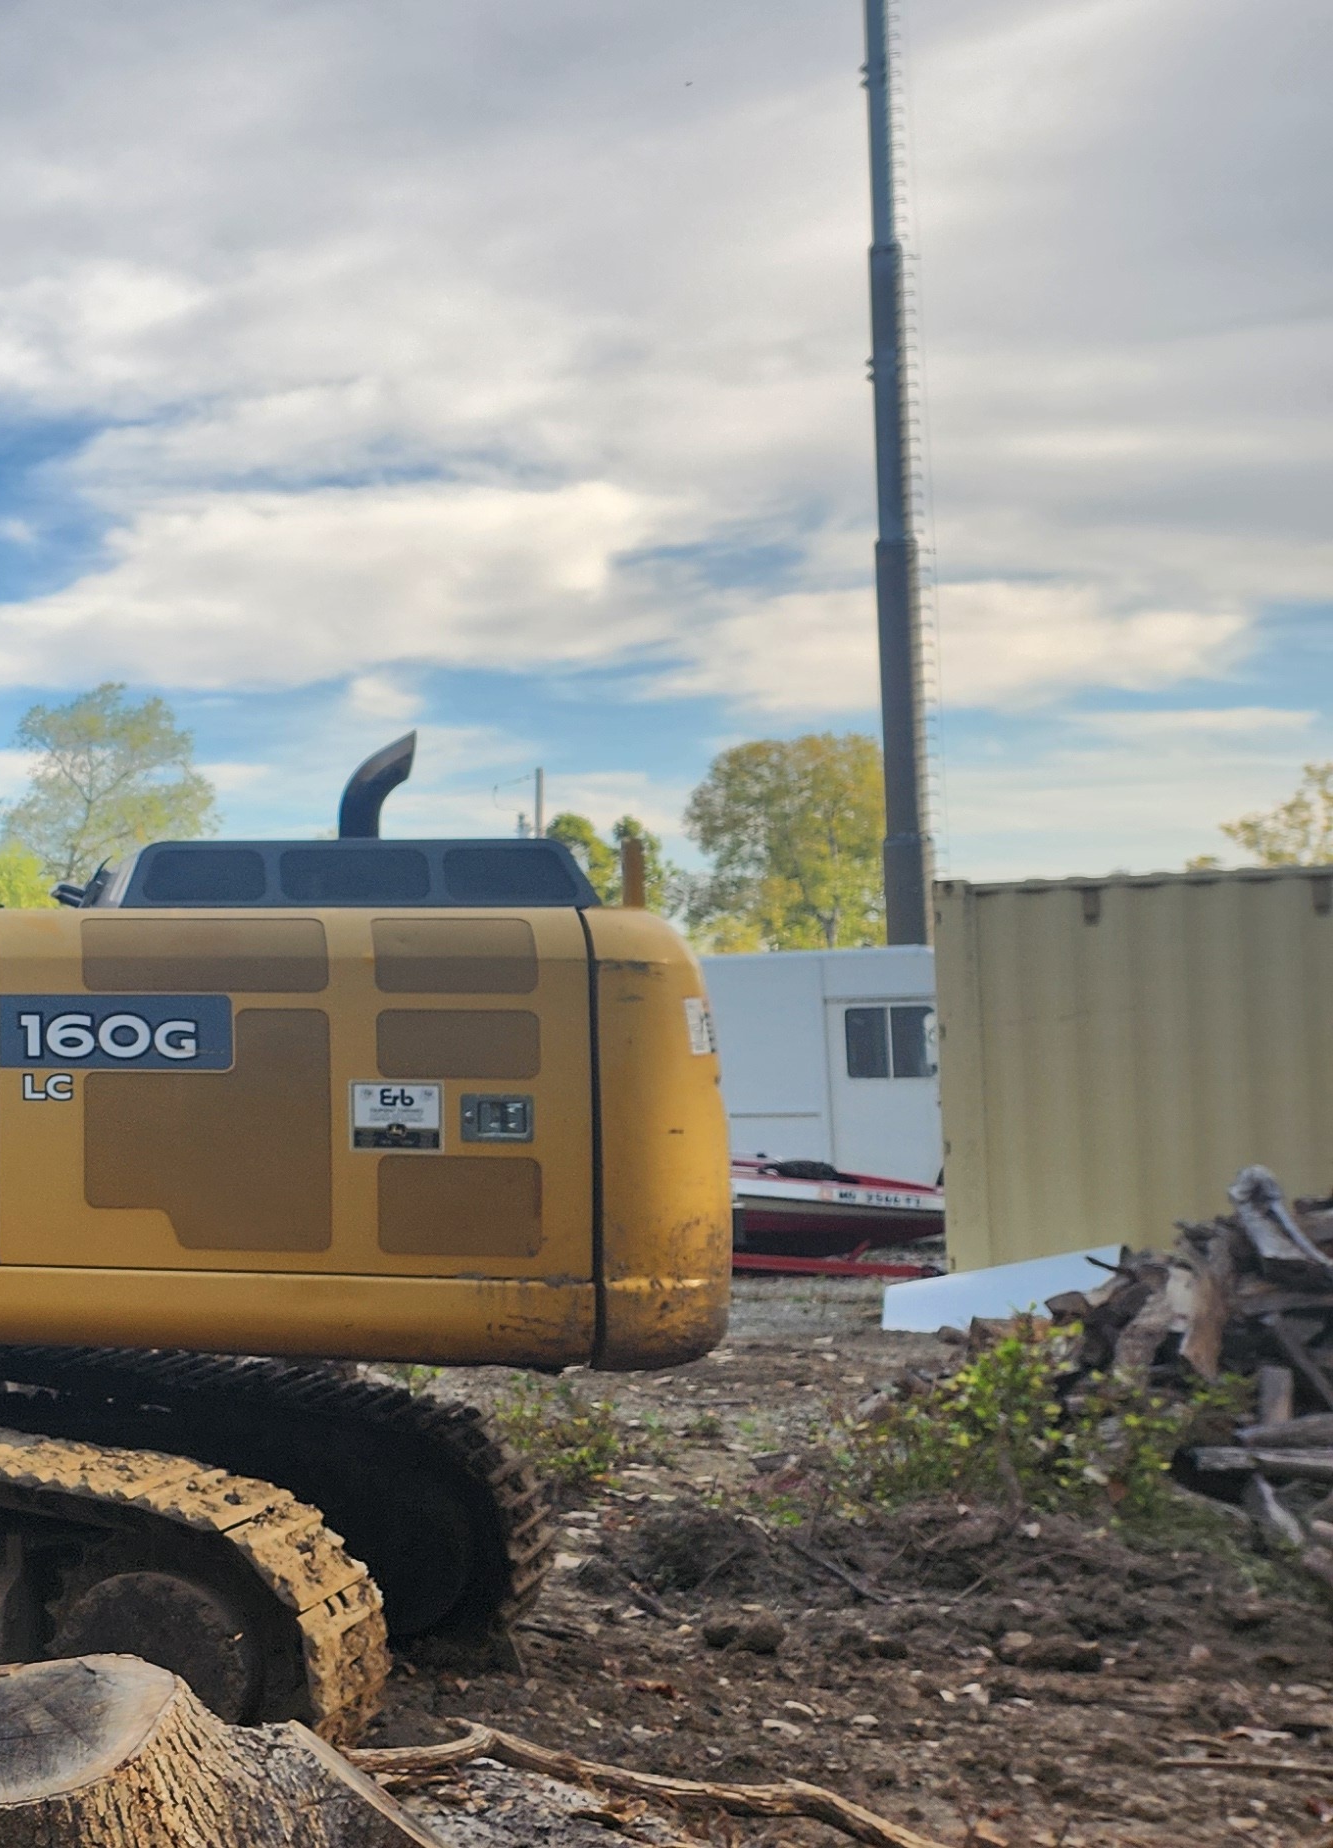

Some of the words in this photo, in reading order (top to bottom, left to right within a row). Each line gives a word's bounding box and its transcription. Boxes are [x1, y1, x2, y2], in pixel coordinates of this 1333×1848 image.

[18, 1012, 197, 1060] 160G
[23, 1073, 73, 1101] LC
[379, 1087, 415, 1107] Erb
